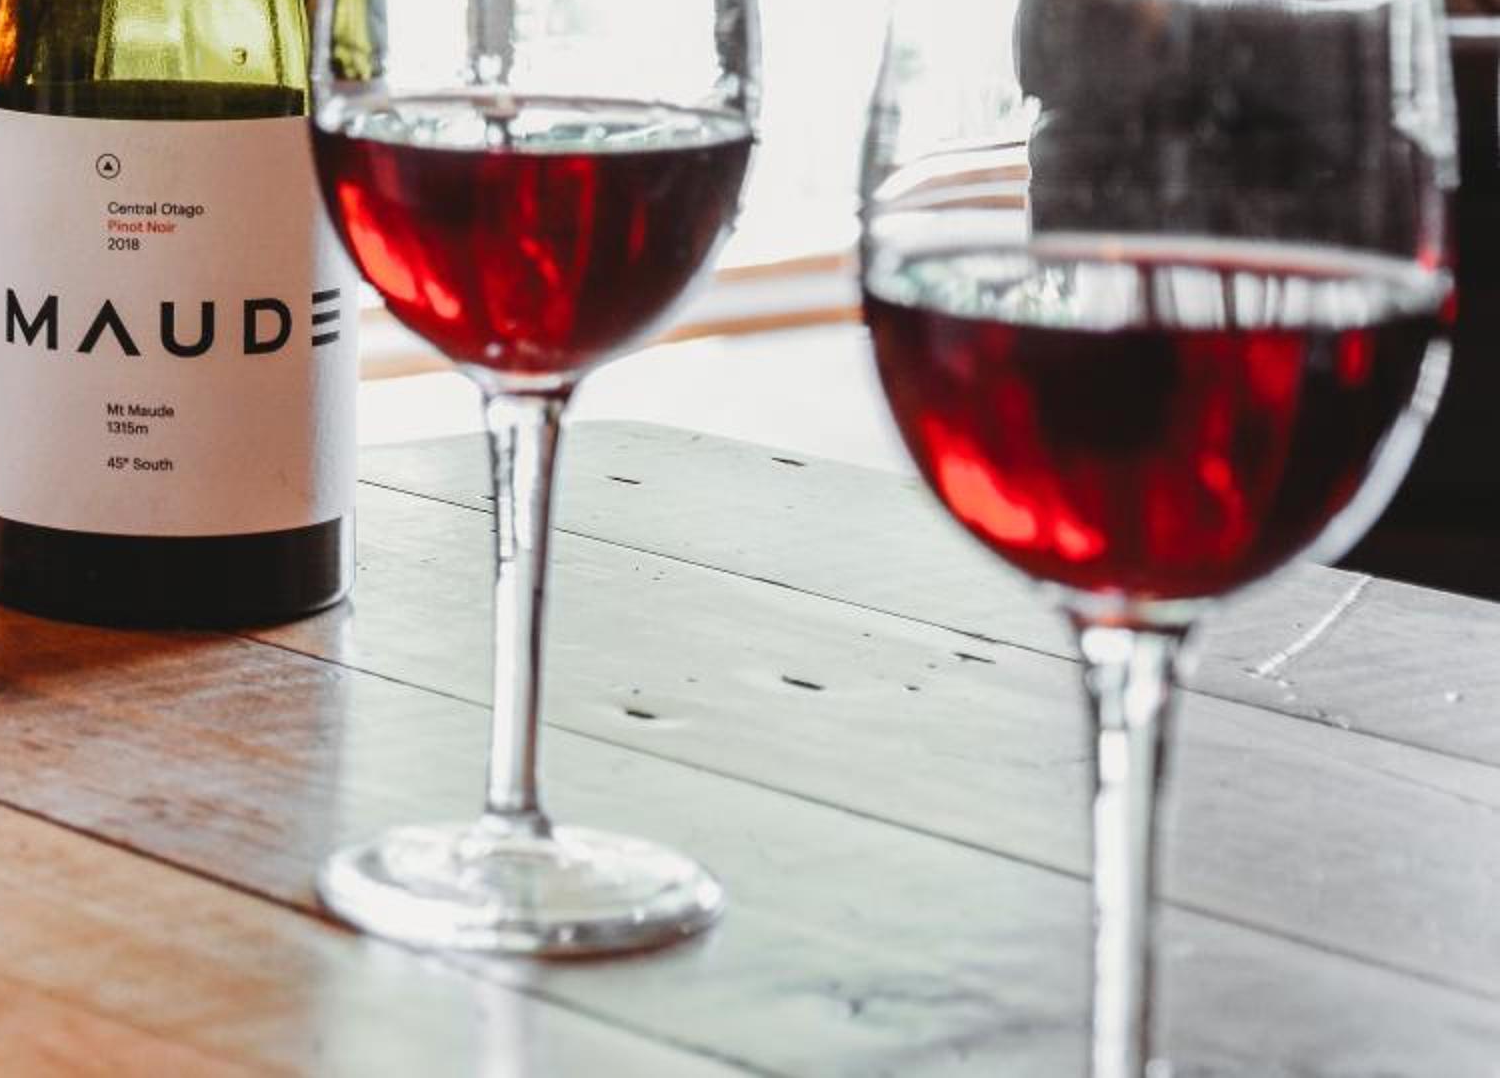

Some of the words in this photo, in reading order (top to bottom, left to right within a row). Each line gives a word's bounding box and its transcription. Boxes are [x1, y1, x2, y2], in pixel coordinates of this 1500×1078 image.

[107, 201, 157, 216] Central
[161, 202, 205, 219] Otago
[107, 219, 144, 233] Pinot
[146, 220, 176, 234] Noir
[107, 236, 141, 251] 2018
[6, 288, 341, 358] MAUDE
[107, 402, 125, 417] Mt
[127, 404, 175, 418] Maude
[107, 420, 149, 435] 1315m
[132, 457, 173, 472] South
